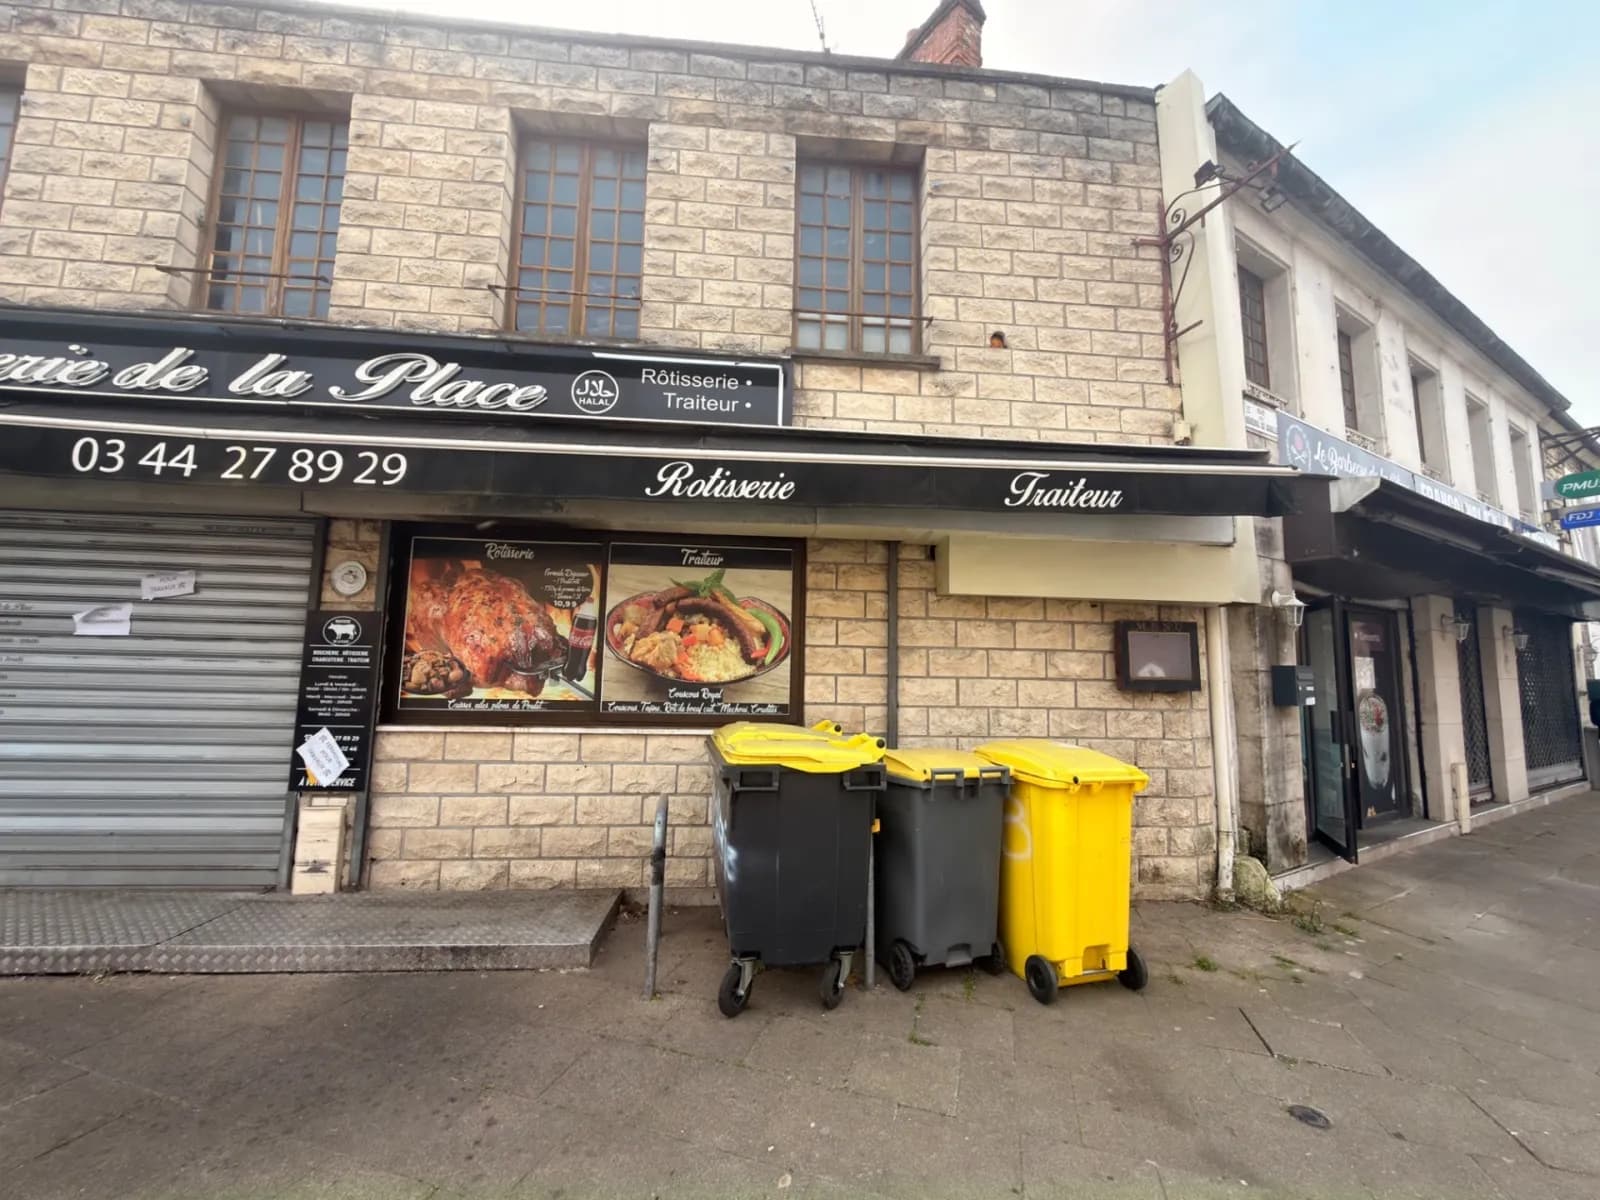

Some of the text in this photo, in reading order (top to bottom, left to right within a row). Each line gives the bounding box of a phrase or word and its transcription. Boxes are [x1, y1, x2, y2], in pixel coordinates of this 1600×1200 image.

[112, 346, 209, 392] de
[228, 353, 313, 397] la
[328, 352, 548, 411] Place
[641, 368, 739, 390] Rôtisserie
[578, 396, 611, 407] HALAL
[663, 391, 739, 412] Traiteur
[71, 437, 408, 486] 03 44 27 89 29
[645, 461, 796, 500] Rotisserie
[1003, 471, 1123, 508] Traiteur
[1568, 510, 1594, 522] FDJ
[681, 548, 724, 566] Traiteur
